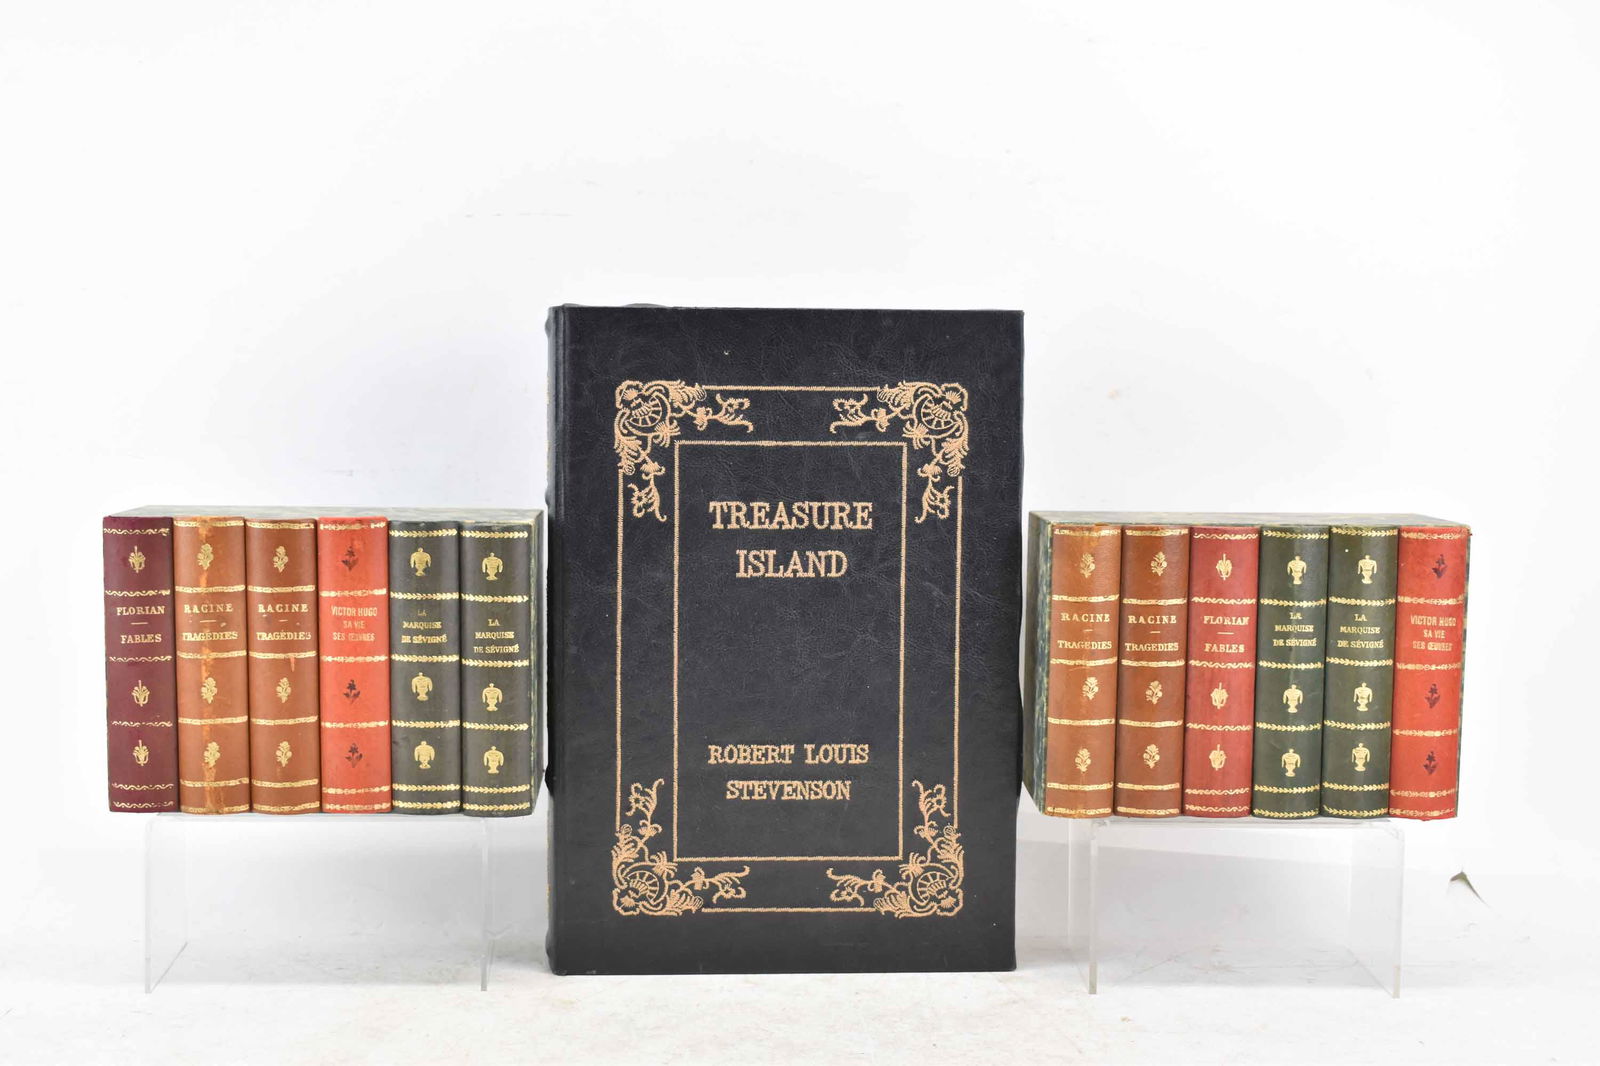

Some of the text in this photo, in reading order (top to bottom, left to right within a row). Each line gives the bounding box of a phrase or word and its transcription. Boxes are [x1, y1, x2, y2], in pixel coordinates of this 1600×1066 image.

[709, 501, 873, 530] TREASURE
[736, 549, 848, 578] ISLAND
[116, 605, 165, 616] FLORIAN
[184, 604, 233, 613] RACINE
[258, 604, 309, 613] RACINE
[331, 606, 377, 616] VICTOR HUGO
[1061, 612, 1110, 622] RACINE
[1128, 615, 1177, 624] RACINE
[1203, 616, 1249, 625] FLORIAN
[1410, 615, 1456, 626] VICTOR HUGO
[343, 620, 365, 629] SA VIE
[403, 621, 442, 629] MARQUISE
[475, 631, 514, 639] MARQUISE
[1340, 626, 1380, 634] MARQUISE
[1423, 629, 1445, 639] SA VIE
[120, 634, 162, 644] FABLES
[333, 632, 346, 640] SES
[401, 634, 448, 643] DE SÉVIGNÉ
[1286, 637, 1317, 647] SÉVIGNÉ
[1337, 639, 1384, 649] DE SÉVIGNÉ
[485, 644, 519, 653] SÉVIGNÉ
[1204, 643, 1245, 653] FABLES
[708, 744, 869, 764] ROBERT LOUIS
[726, 780, 852, 800] STEVENSON
